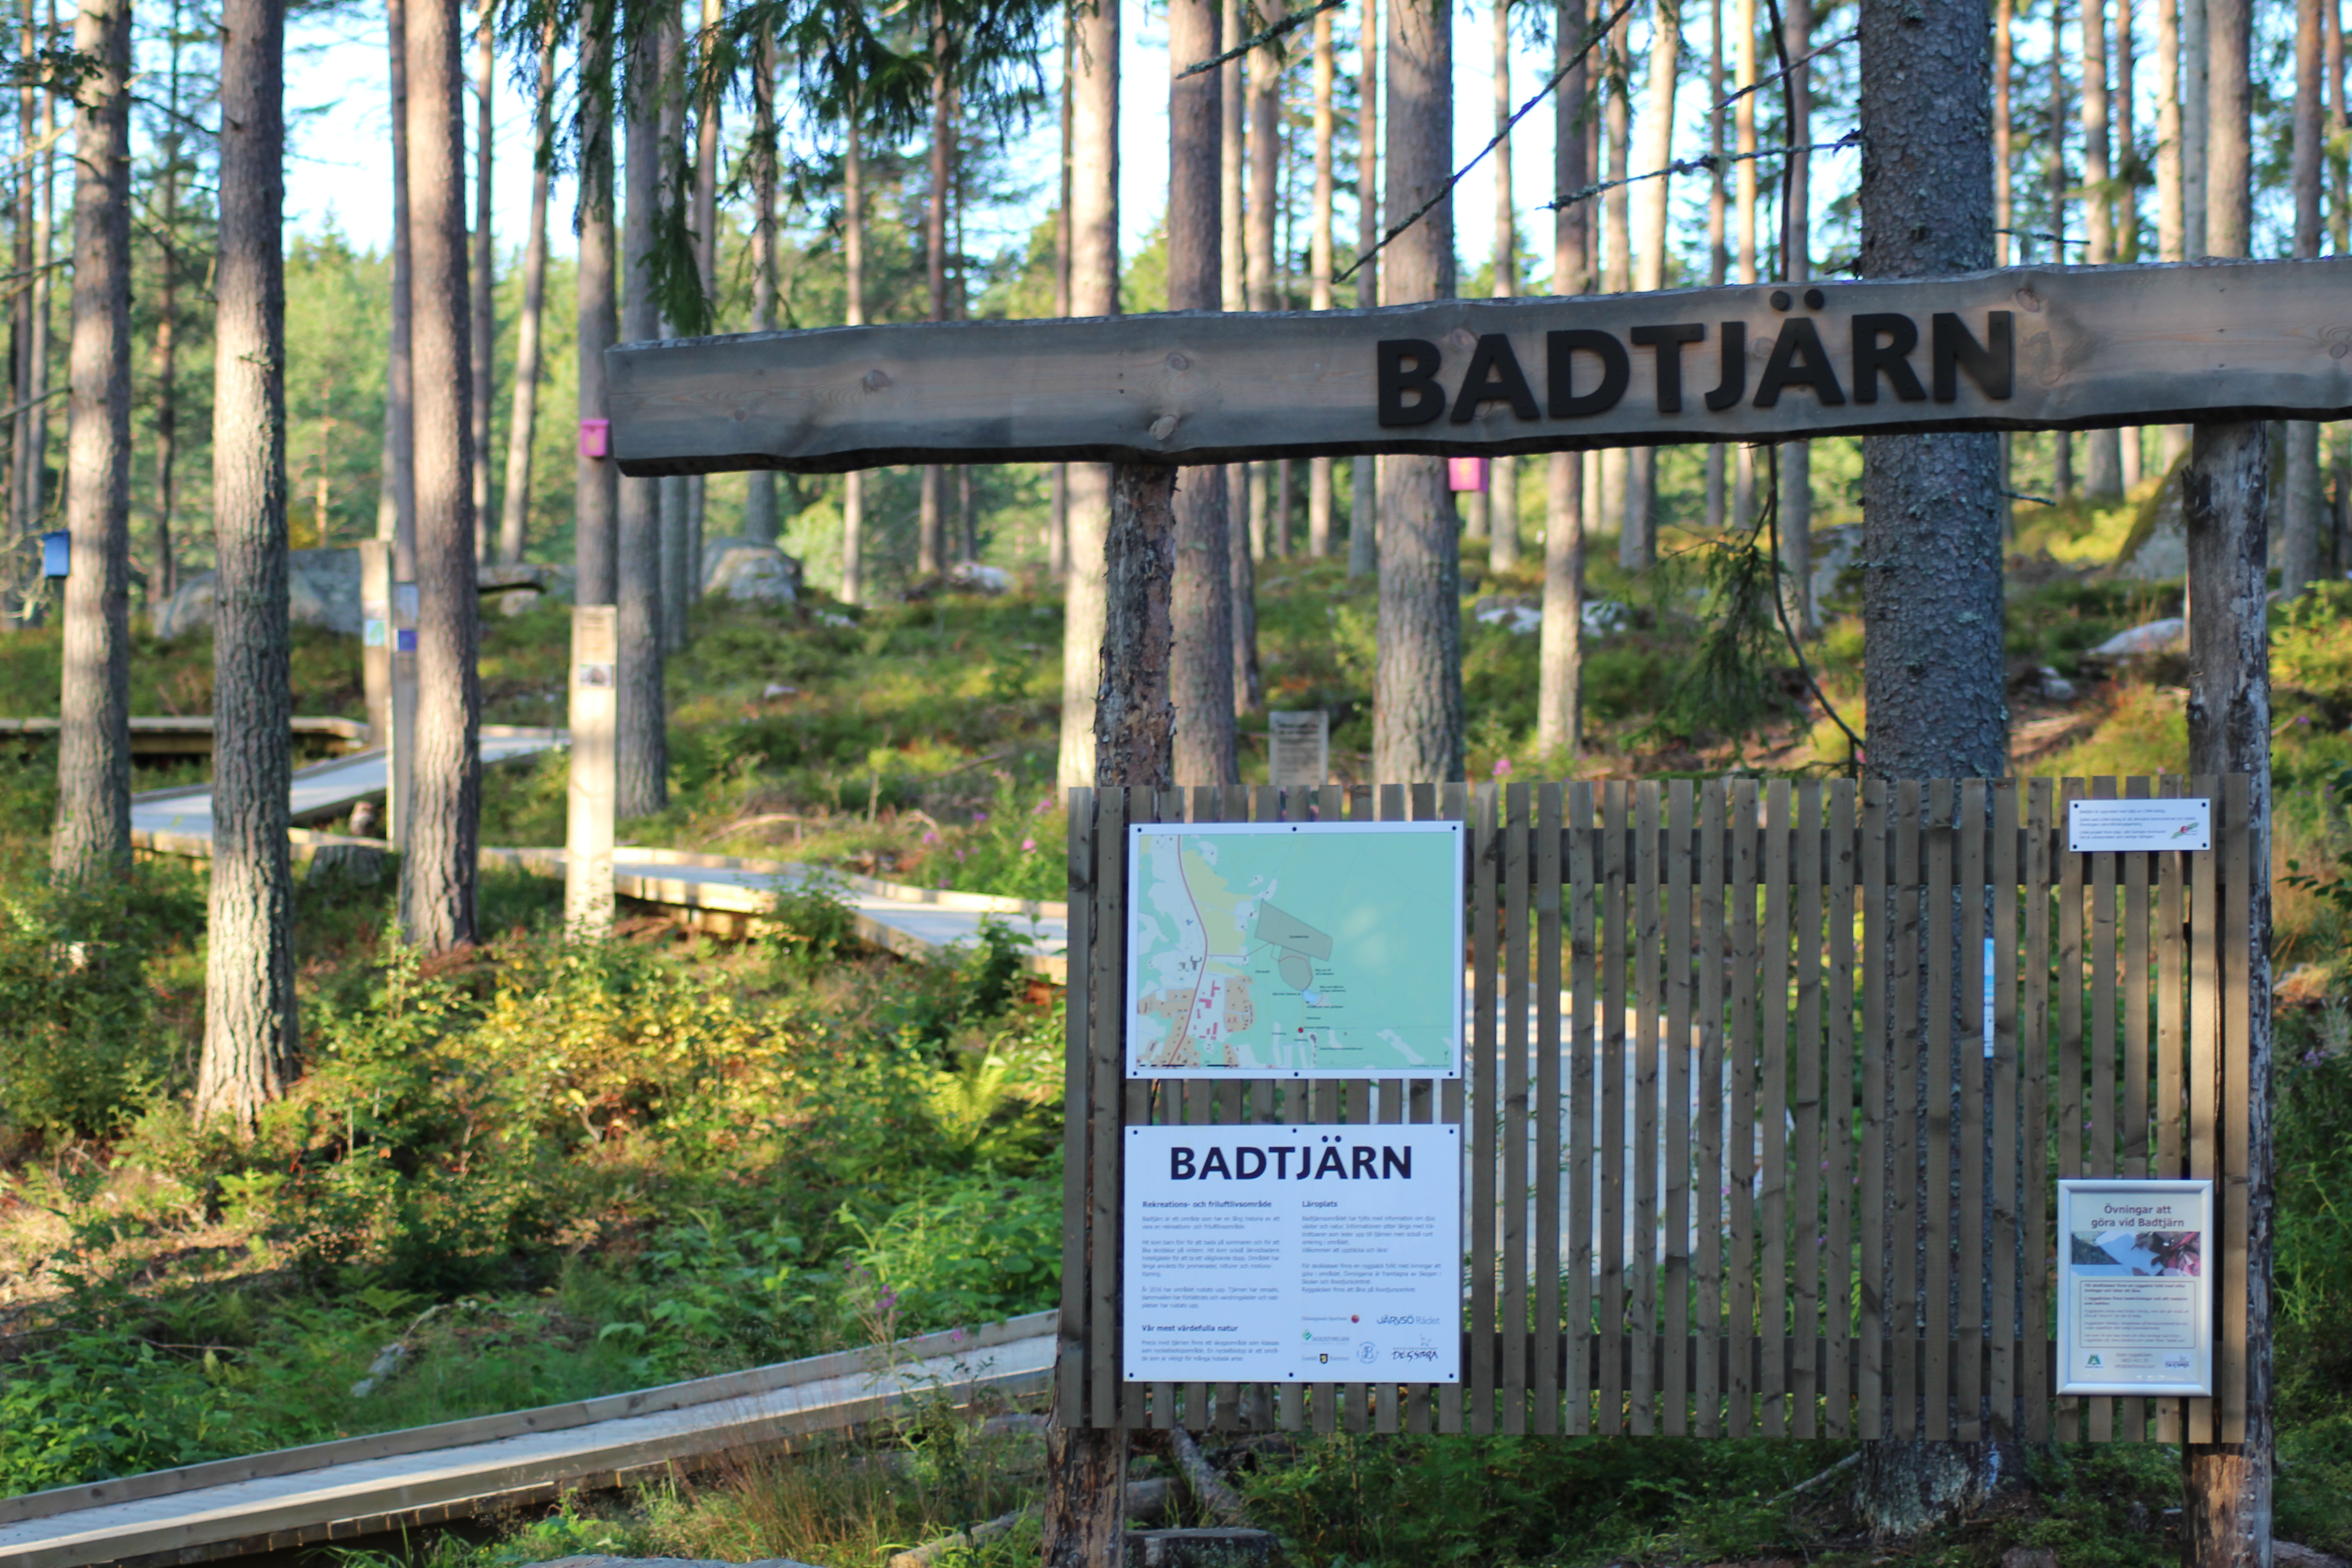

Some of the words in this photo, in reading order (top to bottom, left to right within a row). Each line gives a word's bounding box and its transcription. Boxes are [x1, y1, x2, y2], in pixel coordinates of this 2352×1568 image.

[1377, 289, 2013, 427] BADTJÄRN
[1171, 1135, 1412, 1180] BADTJÄRN
[2091, 1218, 2116, 1229] göra
[2118, 1218, 2135, 1227] vid
[2138, 1218, 2185, 1229] Badtjärn
[2104, 1203, 2153, 1216] Övningar
[2156, 1205, 2171, 1214] att
